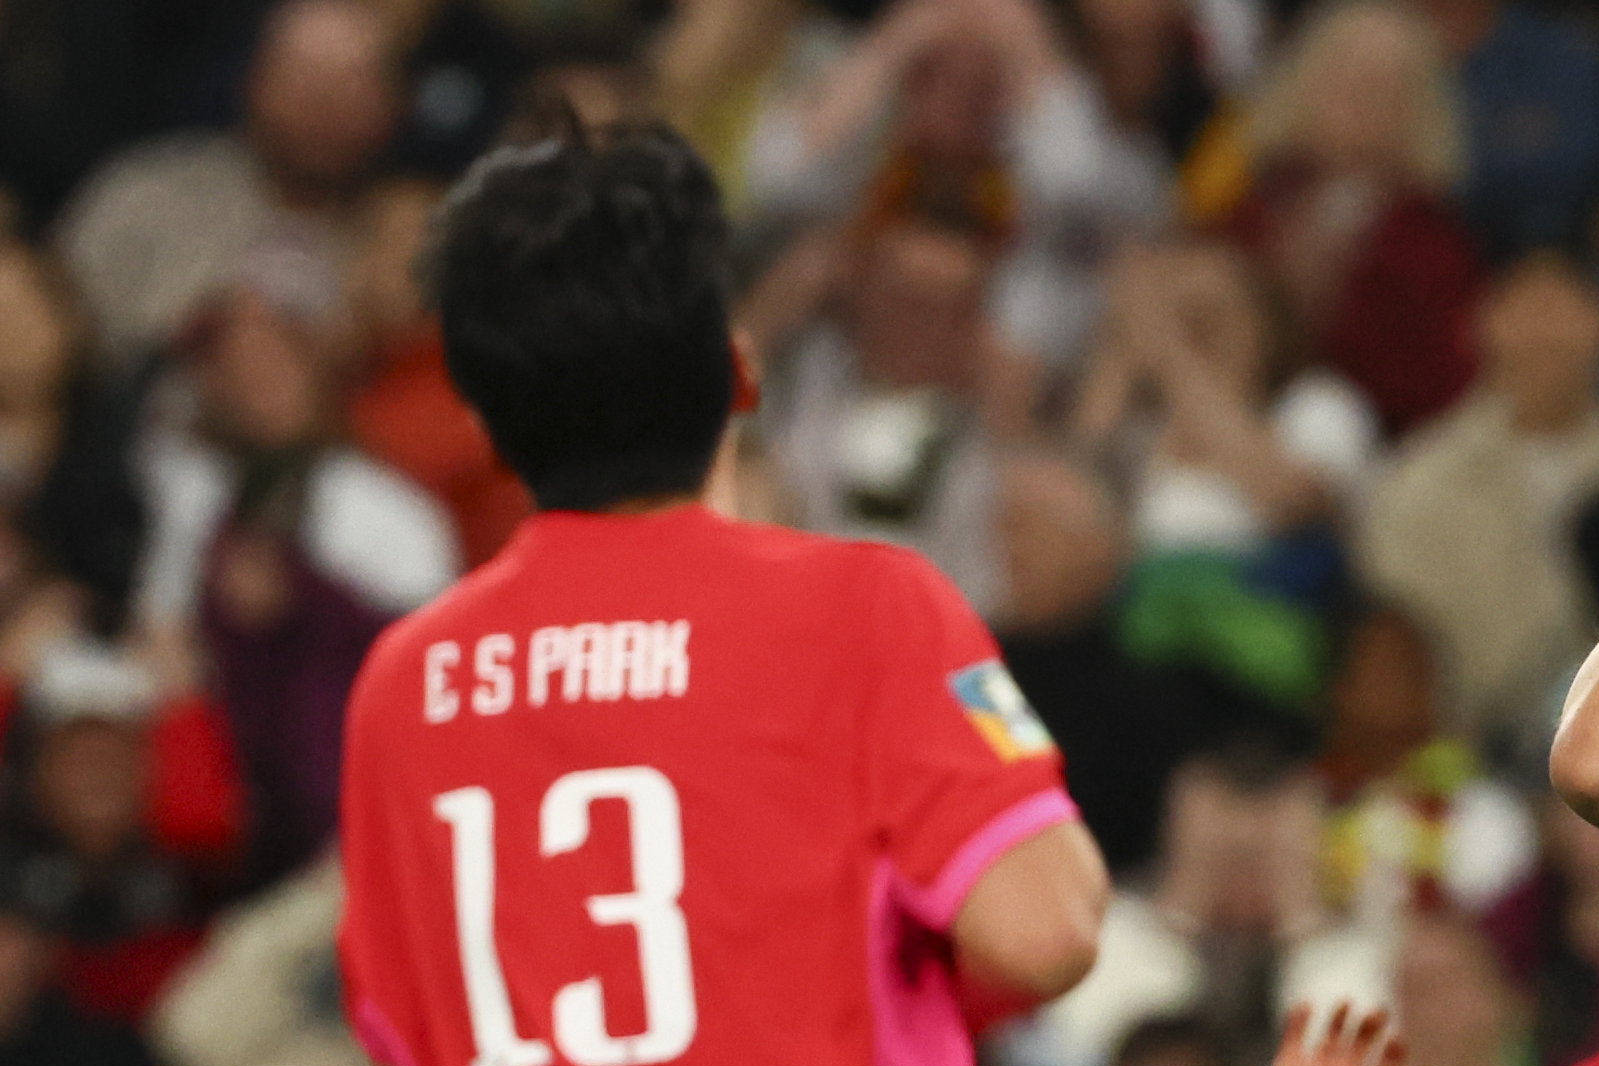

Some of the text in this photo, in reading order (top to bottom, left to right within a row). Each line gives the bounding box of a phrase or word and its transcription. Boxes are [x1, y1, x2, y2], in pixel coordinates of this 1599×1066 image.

[423, 619, 691, 724] E S PARK
